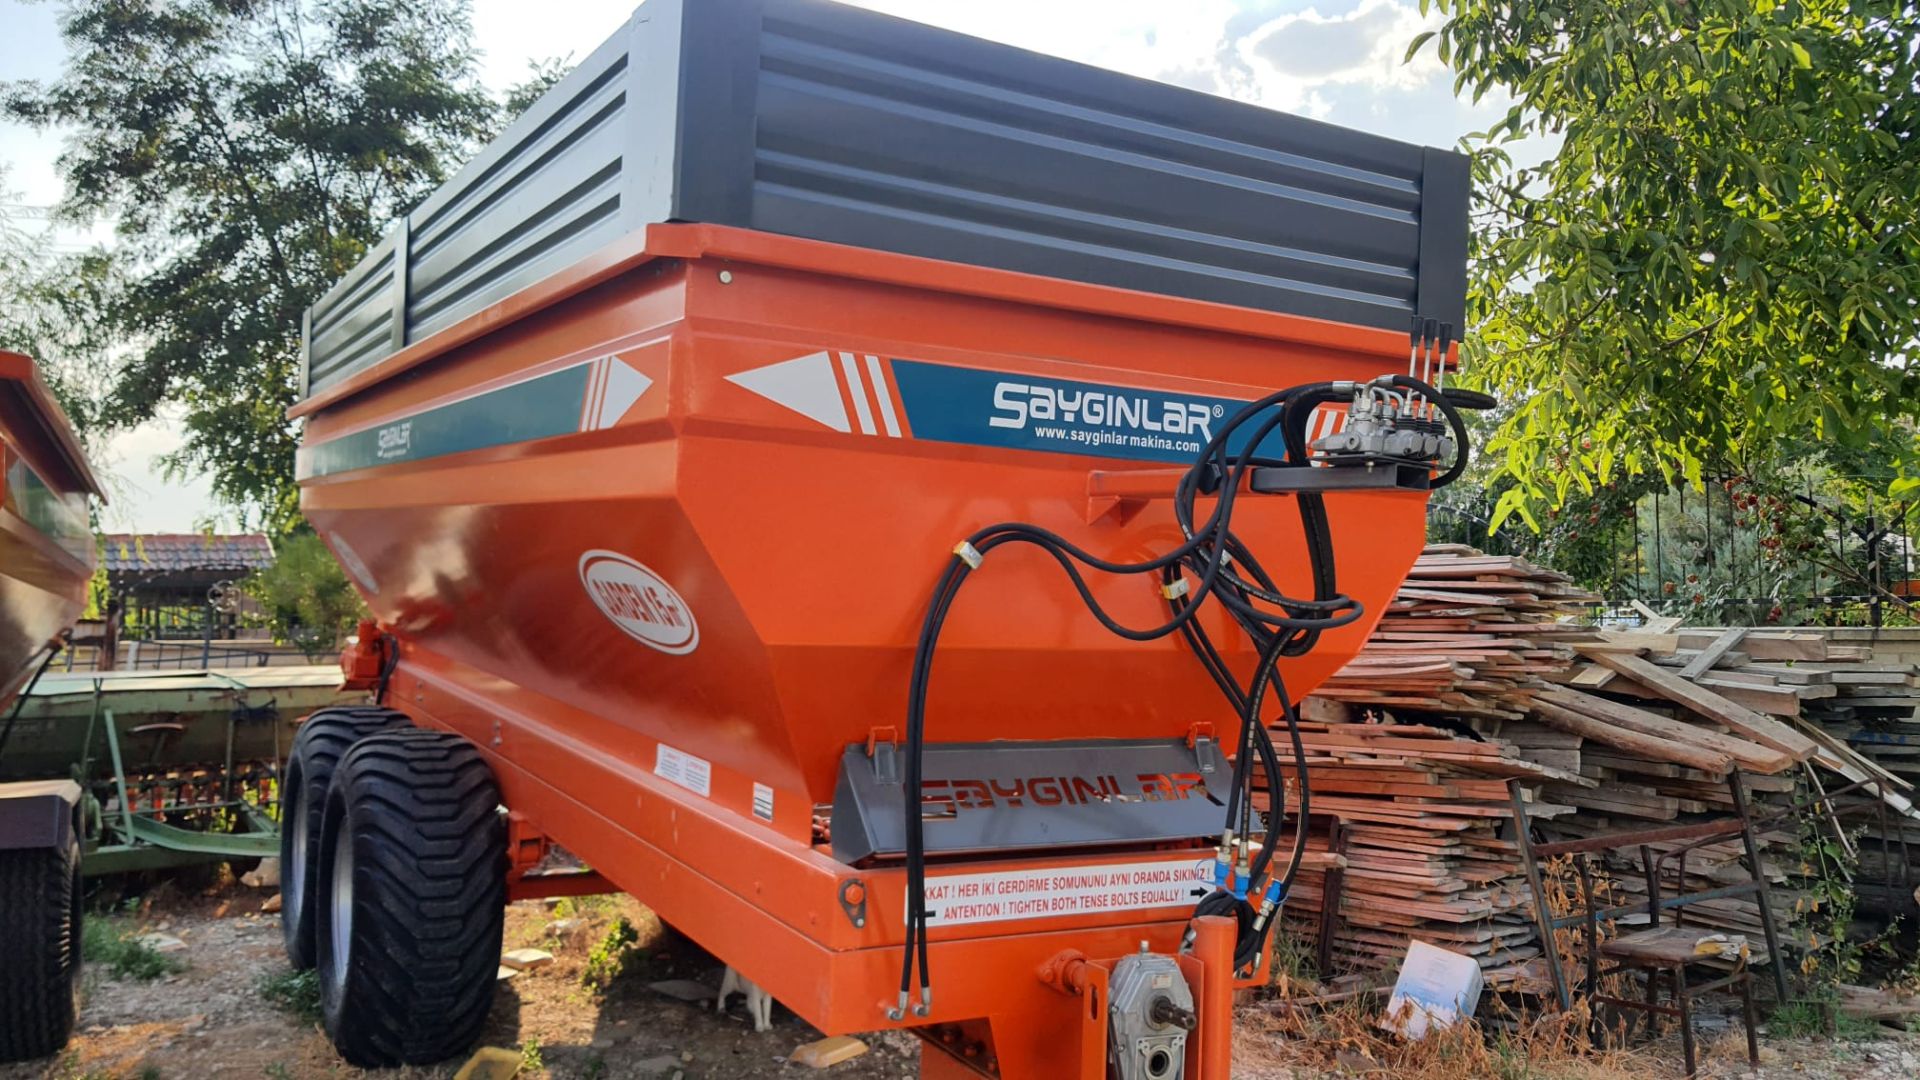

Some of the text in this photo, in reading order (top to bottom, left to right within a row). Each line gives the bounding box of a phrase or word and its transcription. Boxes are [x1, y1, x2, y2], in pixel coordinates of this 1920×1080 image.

[958, 883, 979, 898] HER
[981, 878, 995, 896] İKİ
[997, 876, 1050, 894] GERDİRME
[1052, 874, 1107, 890] SOMUNUNU
[1110, 872, 1130, 886] AYNI
[1133, 870, 1171, 884] ORANDA
[1173, 867, 1205, 882] SIKINIZ
[944, 903, 1000, 920] ANTENTION
[1008, 899, 1049, 914] TIGHTEN
[1051, 896, 1077, 911] BOTH
[1080, 894, 1108, 909] TENSE
[1111, 892, 1139, 907] BOLTS
[1142, 889, 1180, 904] EQUALLY
